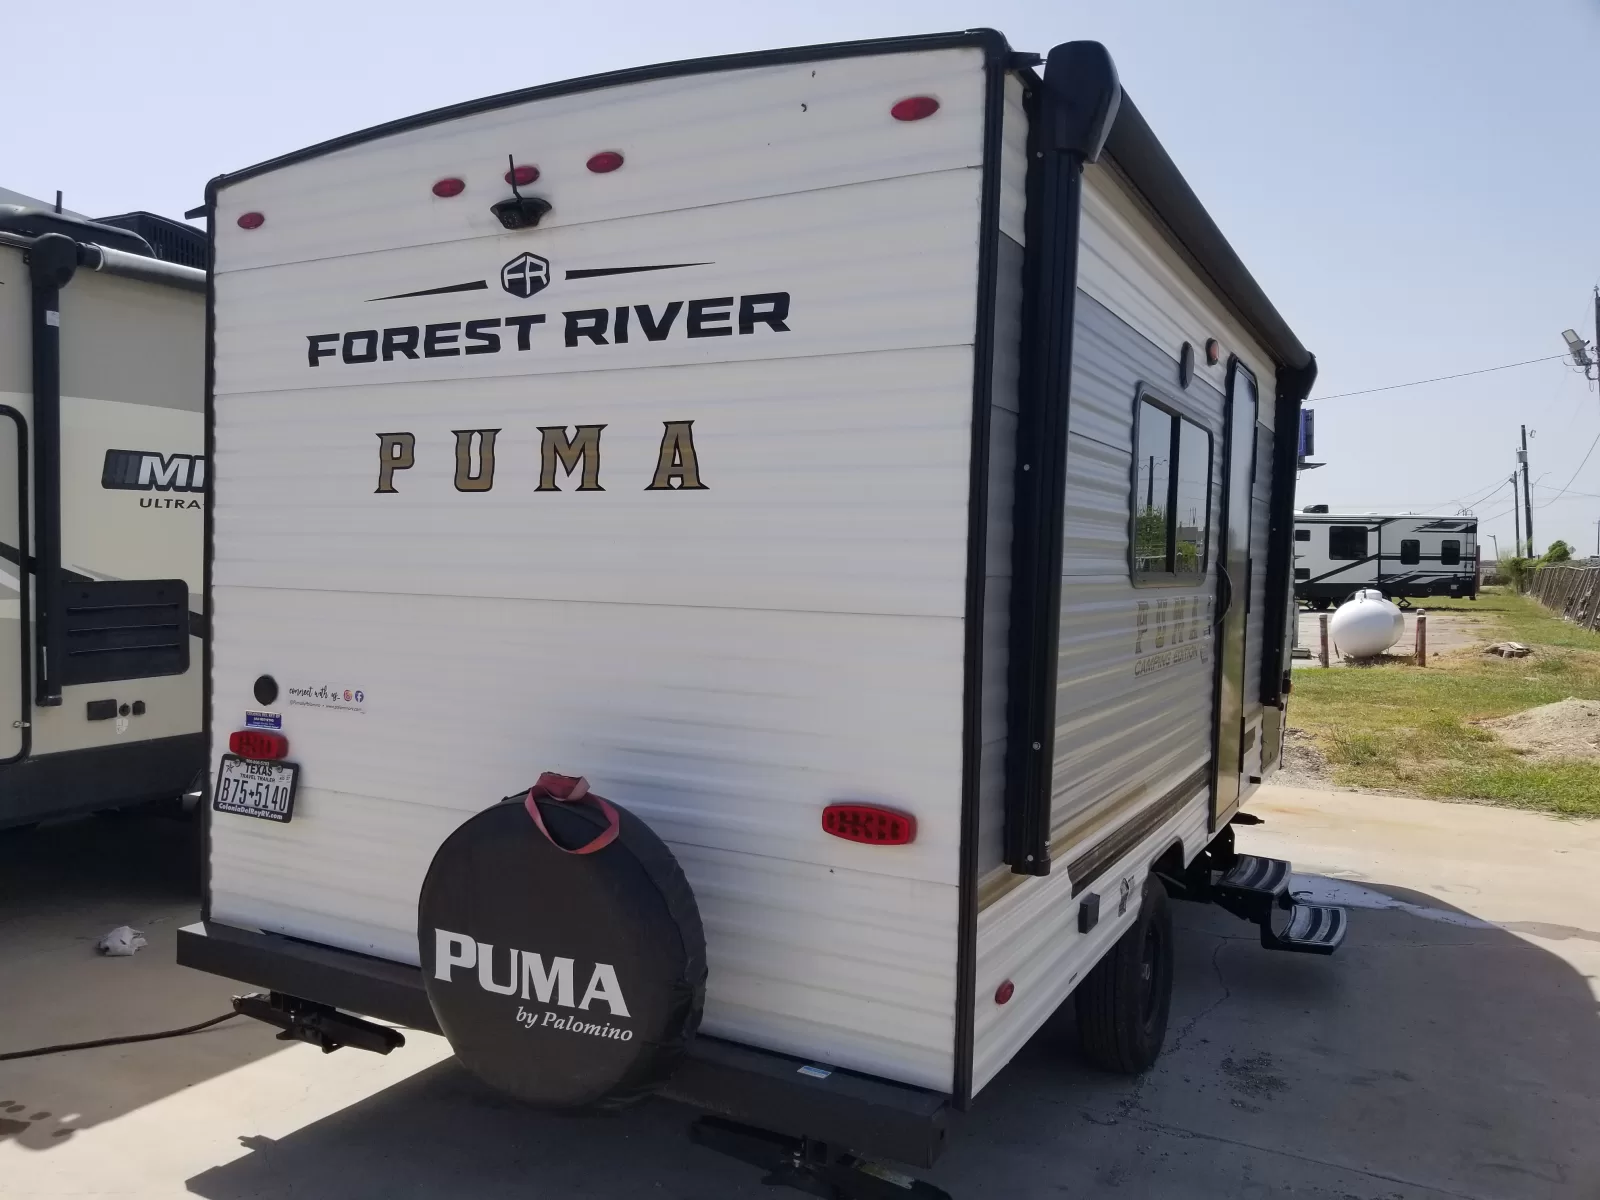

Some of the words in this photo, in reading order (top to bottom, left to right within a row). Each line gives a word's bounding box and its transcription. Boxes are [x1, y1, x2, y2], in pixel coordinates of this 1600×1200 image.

[306, 313, 546, 367] FOREST
[561, 292, 791, 348] RIVER
[373, 420, 710, 494] PUMA
[1135, 596, 1199, 654] PUMA
[288, 685, 313, 698] connect
[314, 684, 328, 699] with
[240, 772, 256, 781] TRAVEL
[257, 775, 276, 784] TRAILER
[245, 762, 273, 777] TEXAS
[218, 802, 283, 821] ColoniaDelReyRV.com
[221, 777, 249, 804] B75
[254, 782, 289, 812] 5140
[434, 928, 631, 1017] PUMA
[515, 1006, 538, 1029] by
[541, 1011, 633, 1041] Palomino
